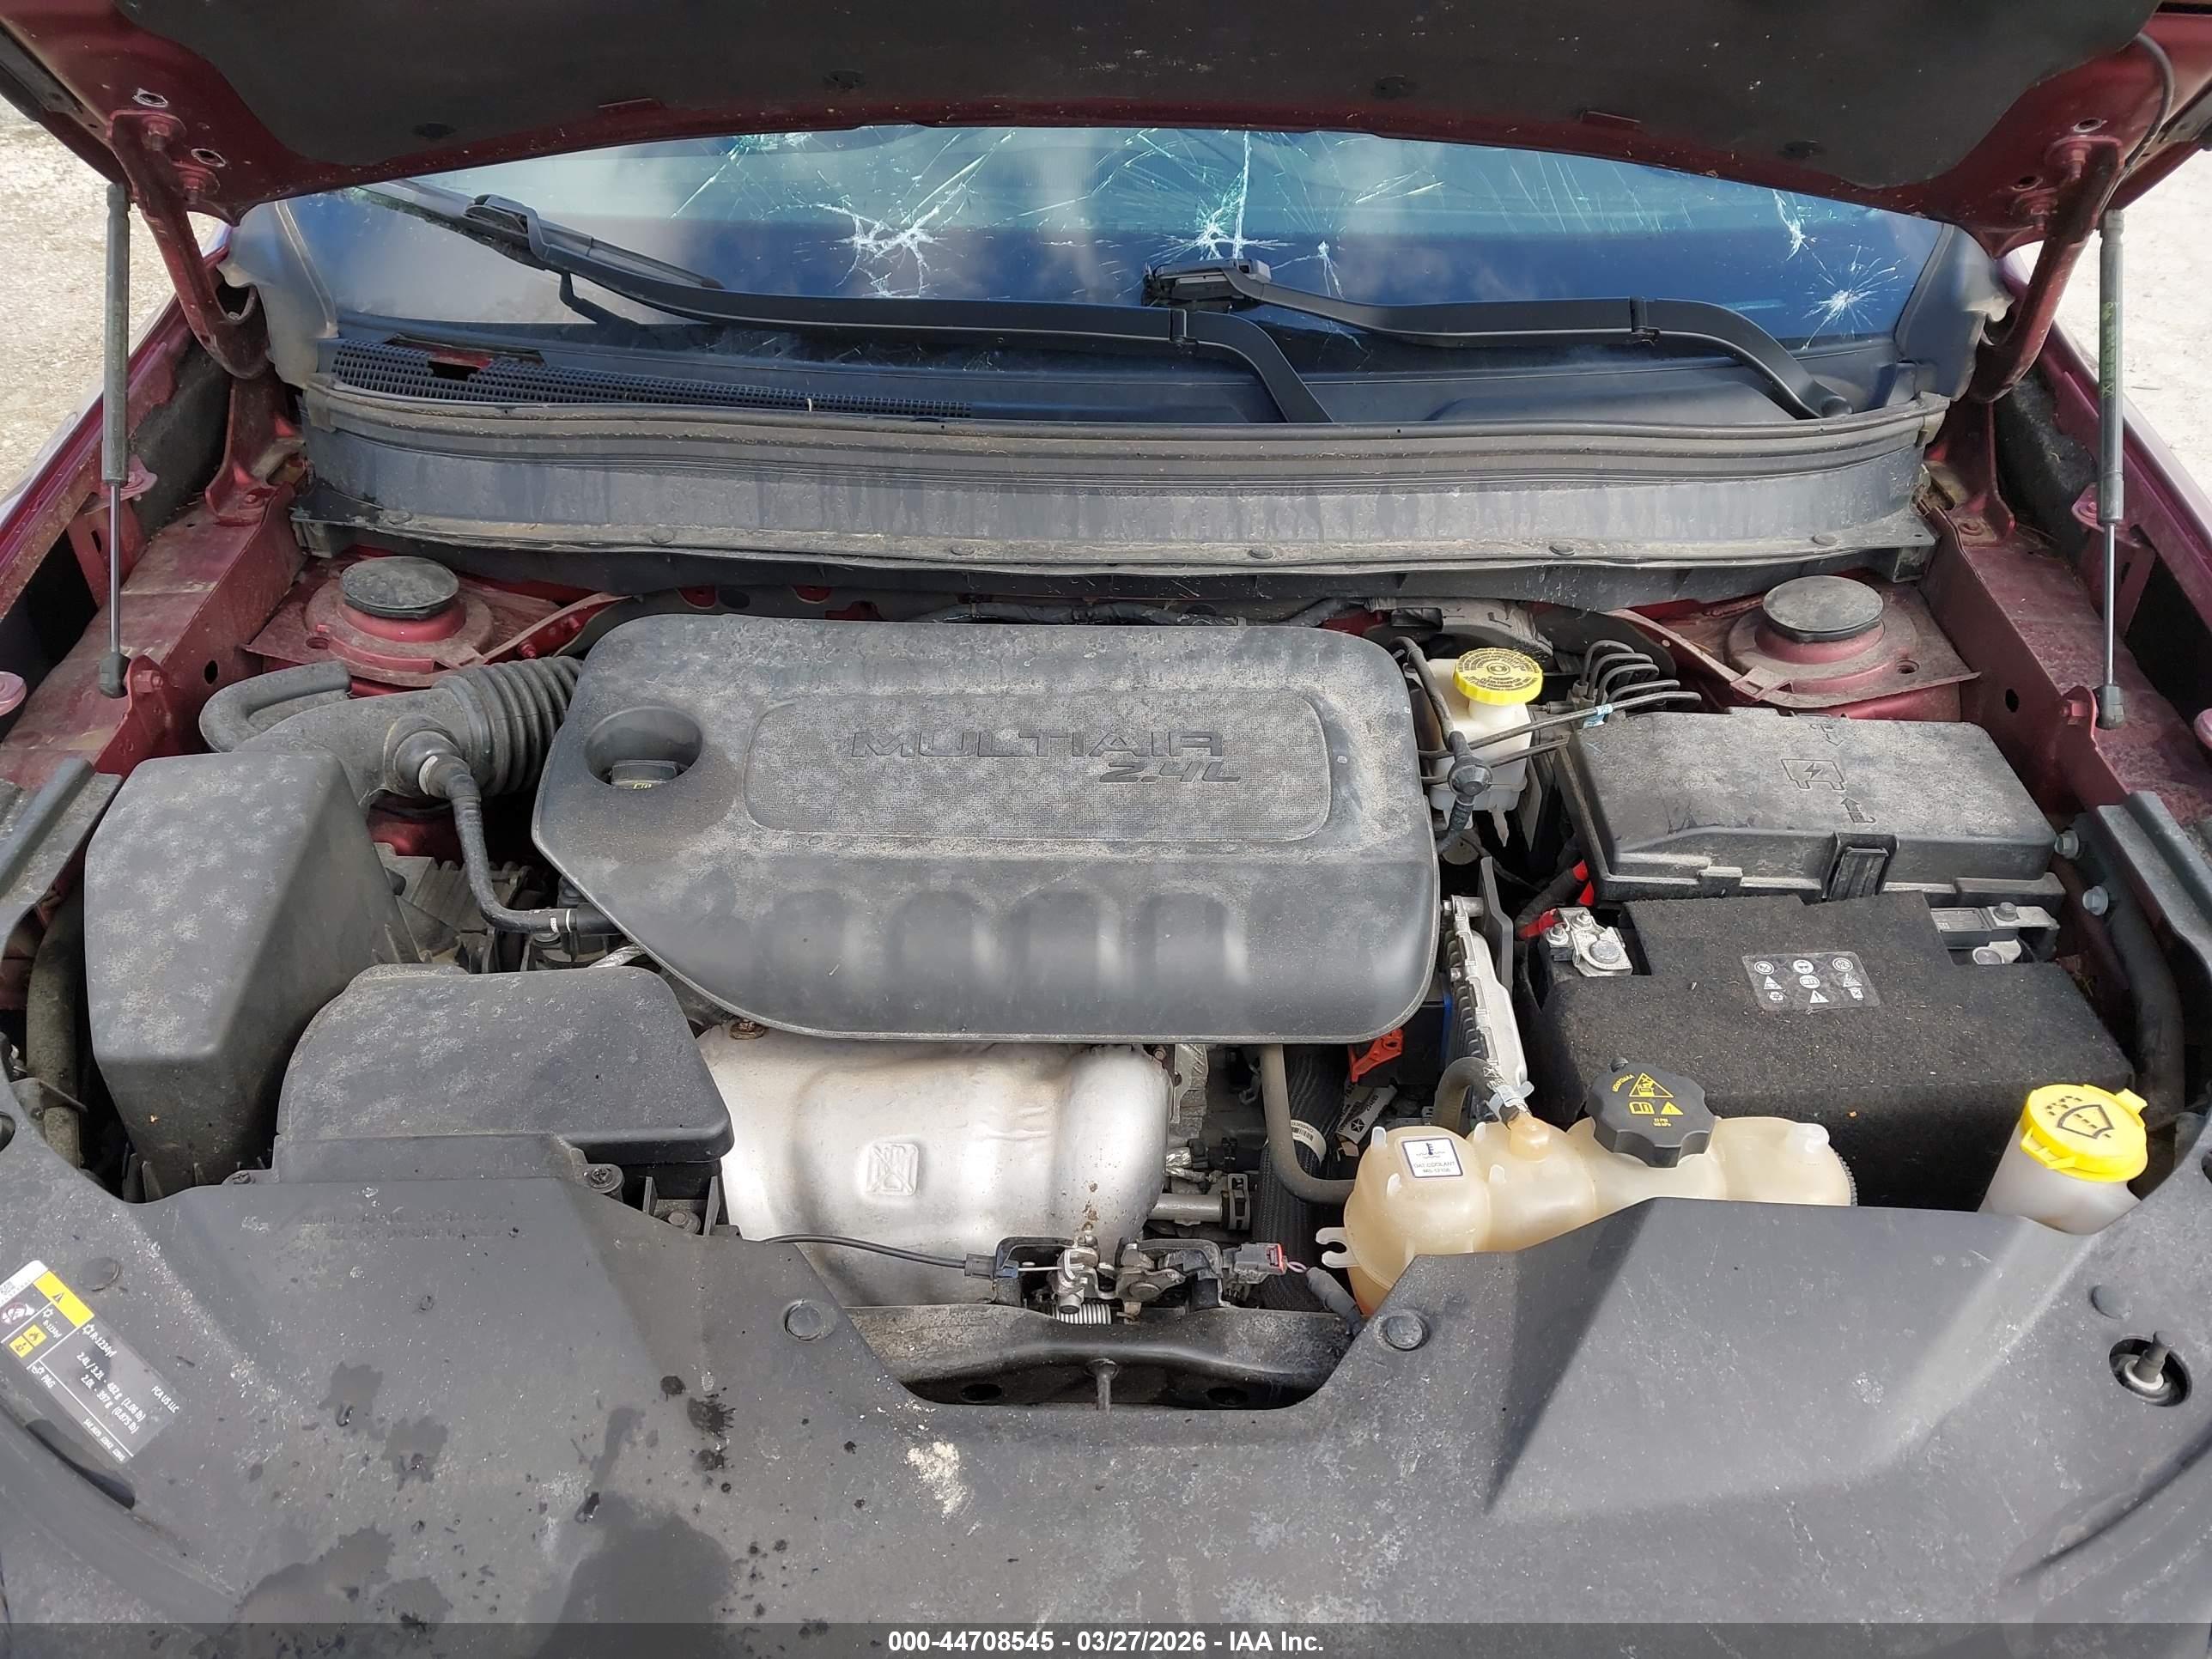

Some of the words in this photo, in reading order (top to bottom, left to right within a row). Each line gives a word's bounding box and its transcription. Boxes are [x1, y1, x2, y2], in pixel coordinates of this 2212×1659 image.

[851, 731, 1224, 757] MULTIAIR
[1099, 761, 1242, 782] 2.4L
[89, 1332, 118, 1358] R-1234yf
[41, 1374, 56, 1389] PAG
[151, 1385, 164, 1400] FCA
[161, 1394, 172, 1406] US
[167, 1401, 179, 1413] LLC
[134, 1409, 146, 1423] lb)
[128, 1421, 139, 1435] lb)
